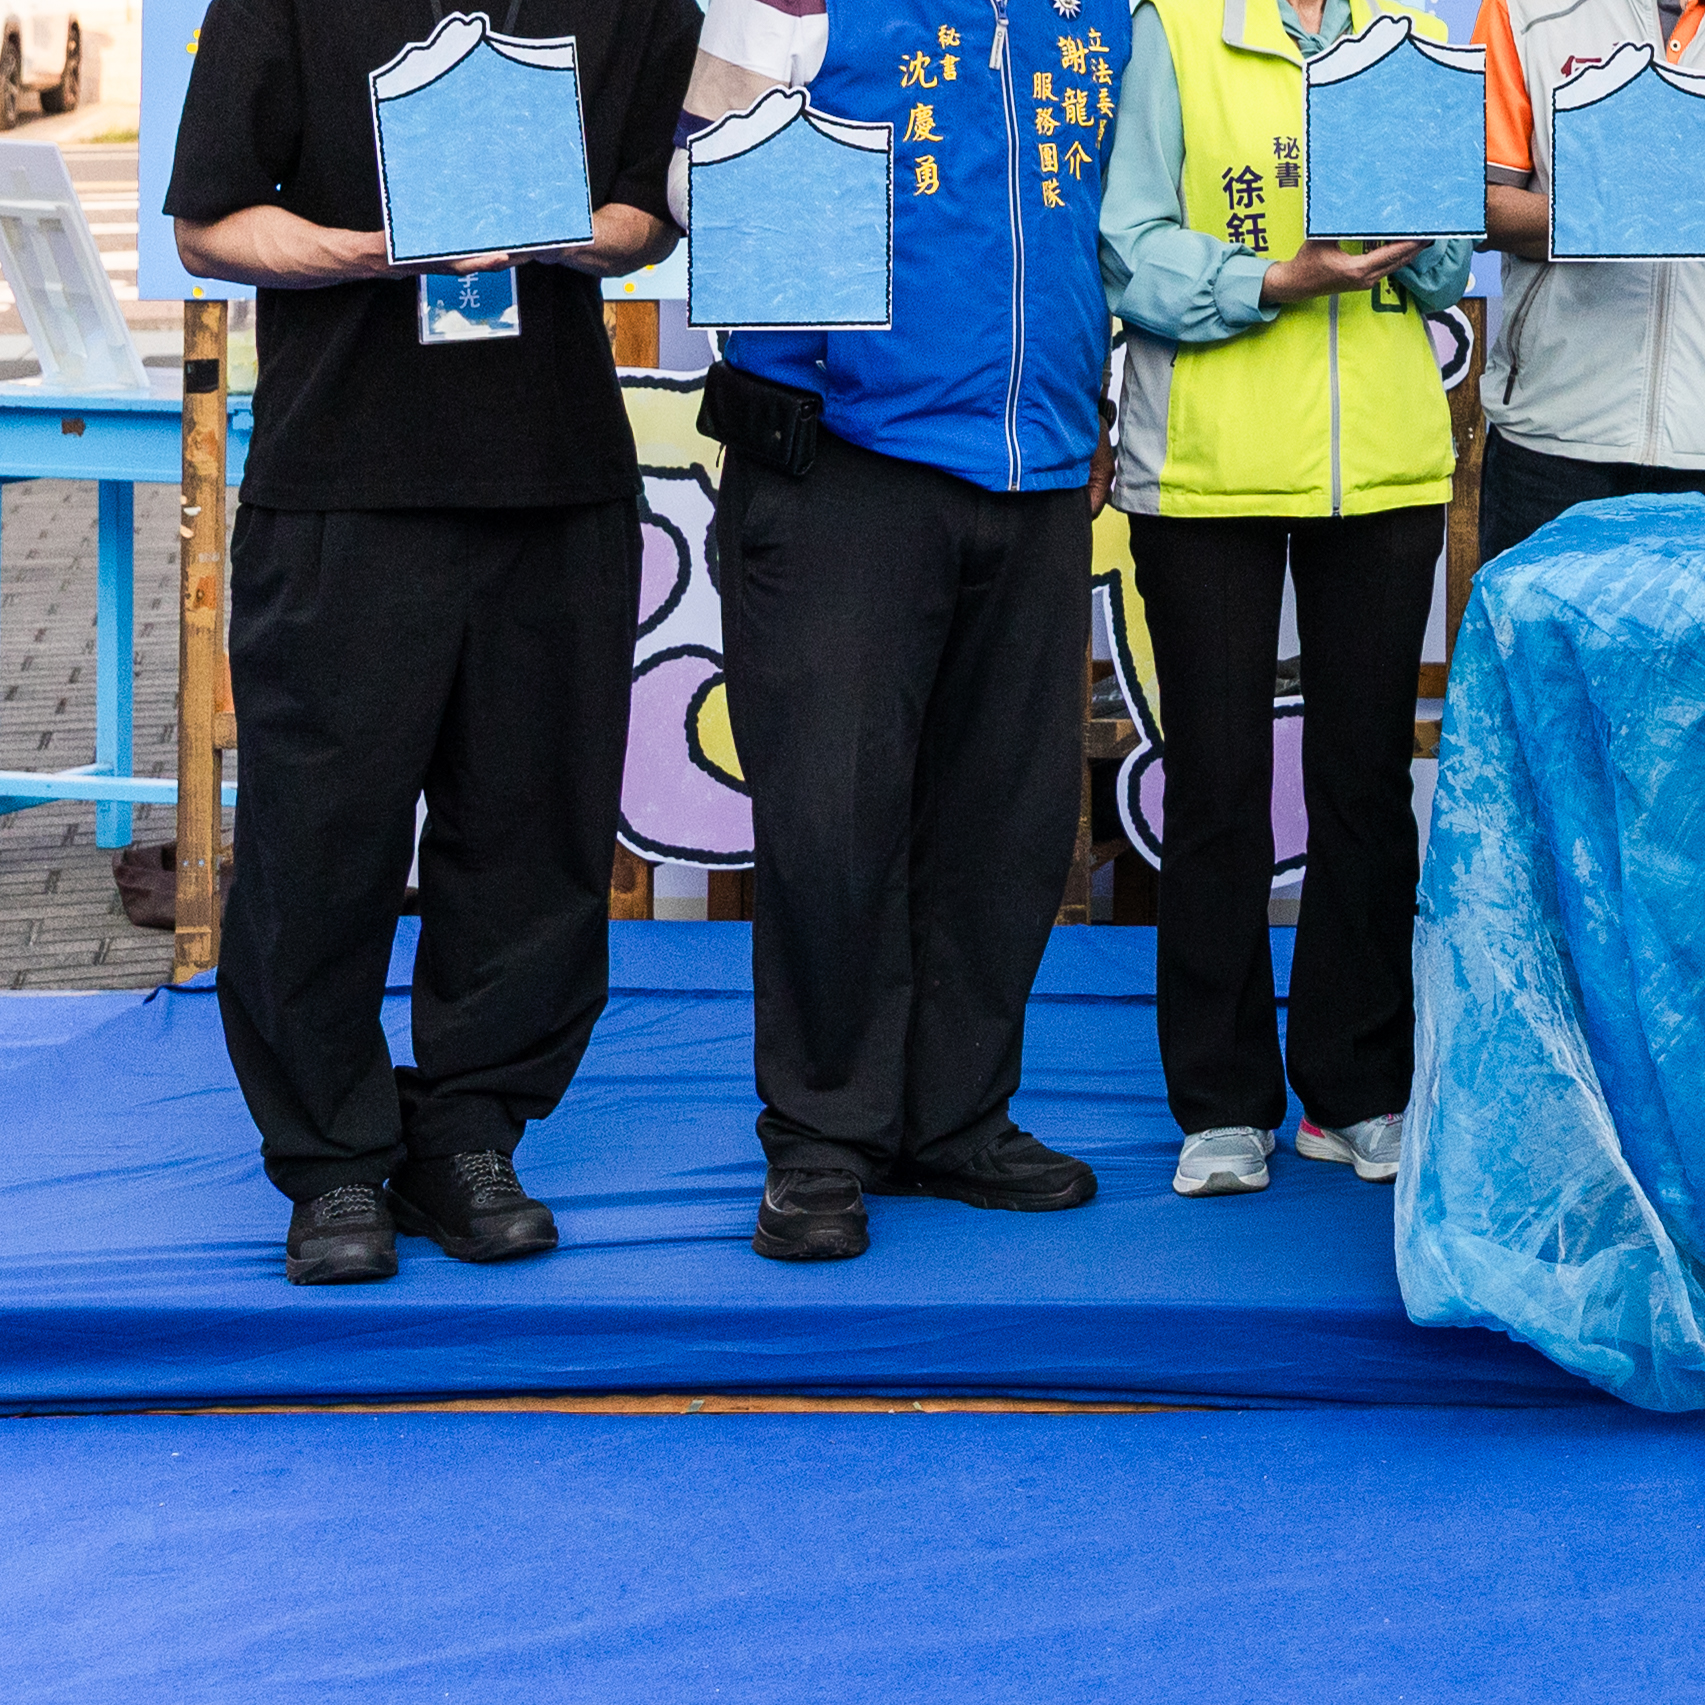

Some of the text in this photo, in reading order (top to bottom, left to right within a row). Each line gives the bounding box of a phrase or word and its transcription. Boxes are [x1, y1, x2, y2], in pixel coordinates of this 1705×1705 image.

[898, 50, 944, 196] 沈慶勇
[1032, 71, 1066, 209] 服務團隊
[1057, 35, 1095, 180] 謝龍介
[1273, 136, 1301, 188] 秘書
